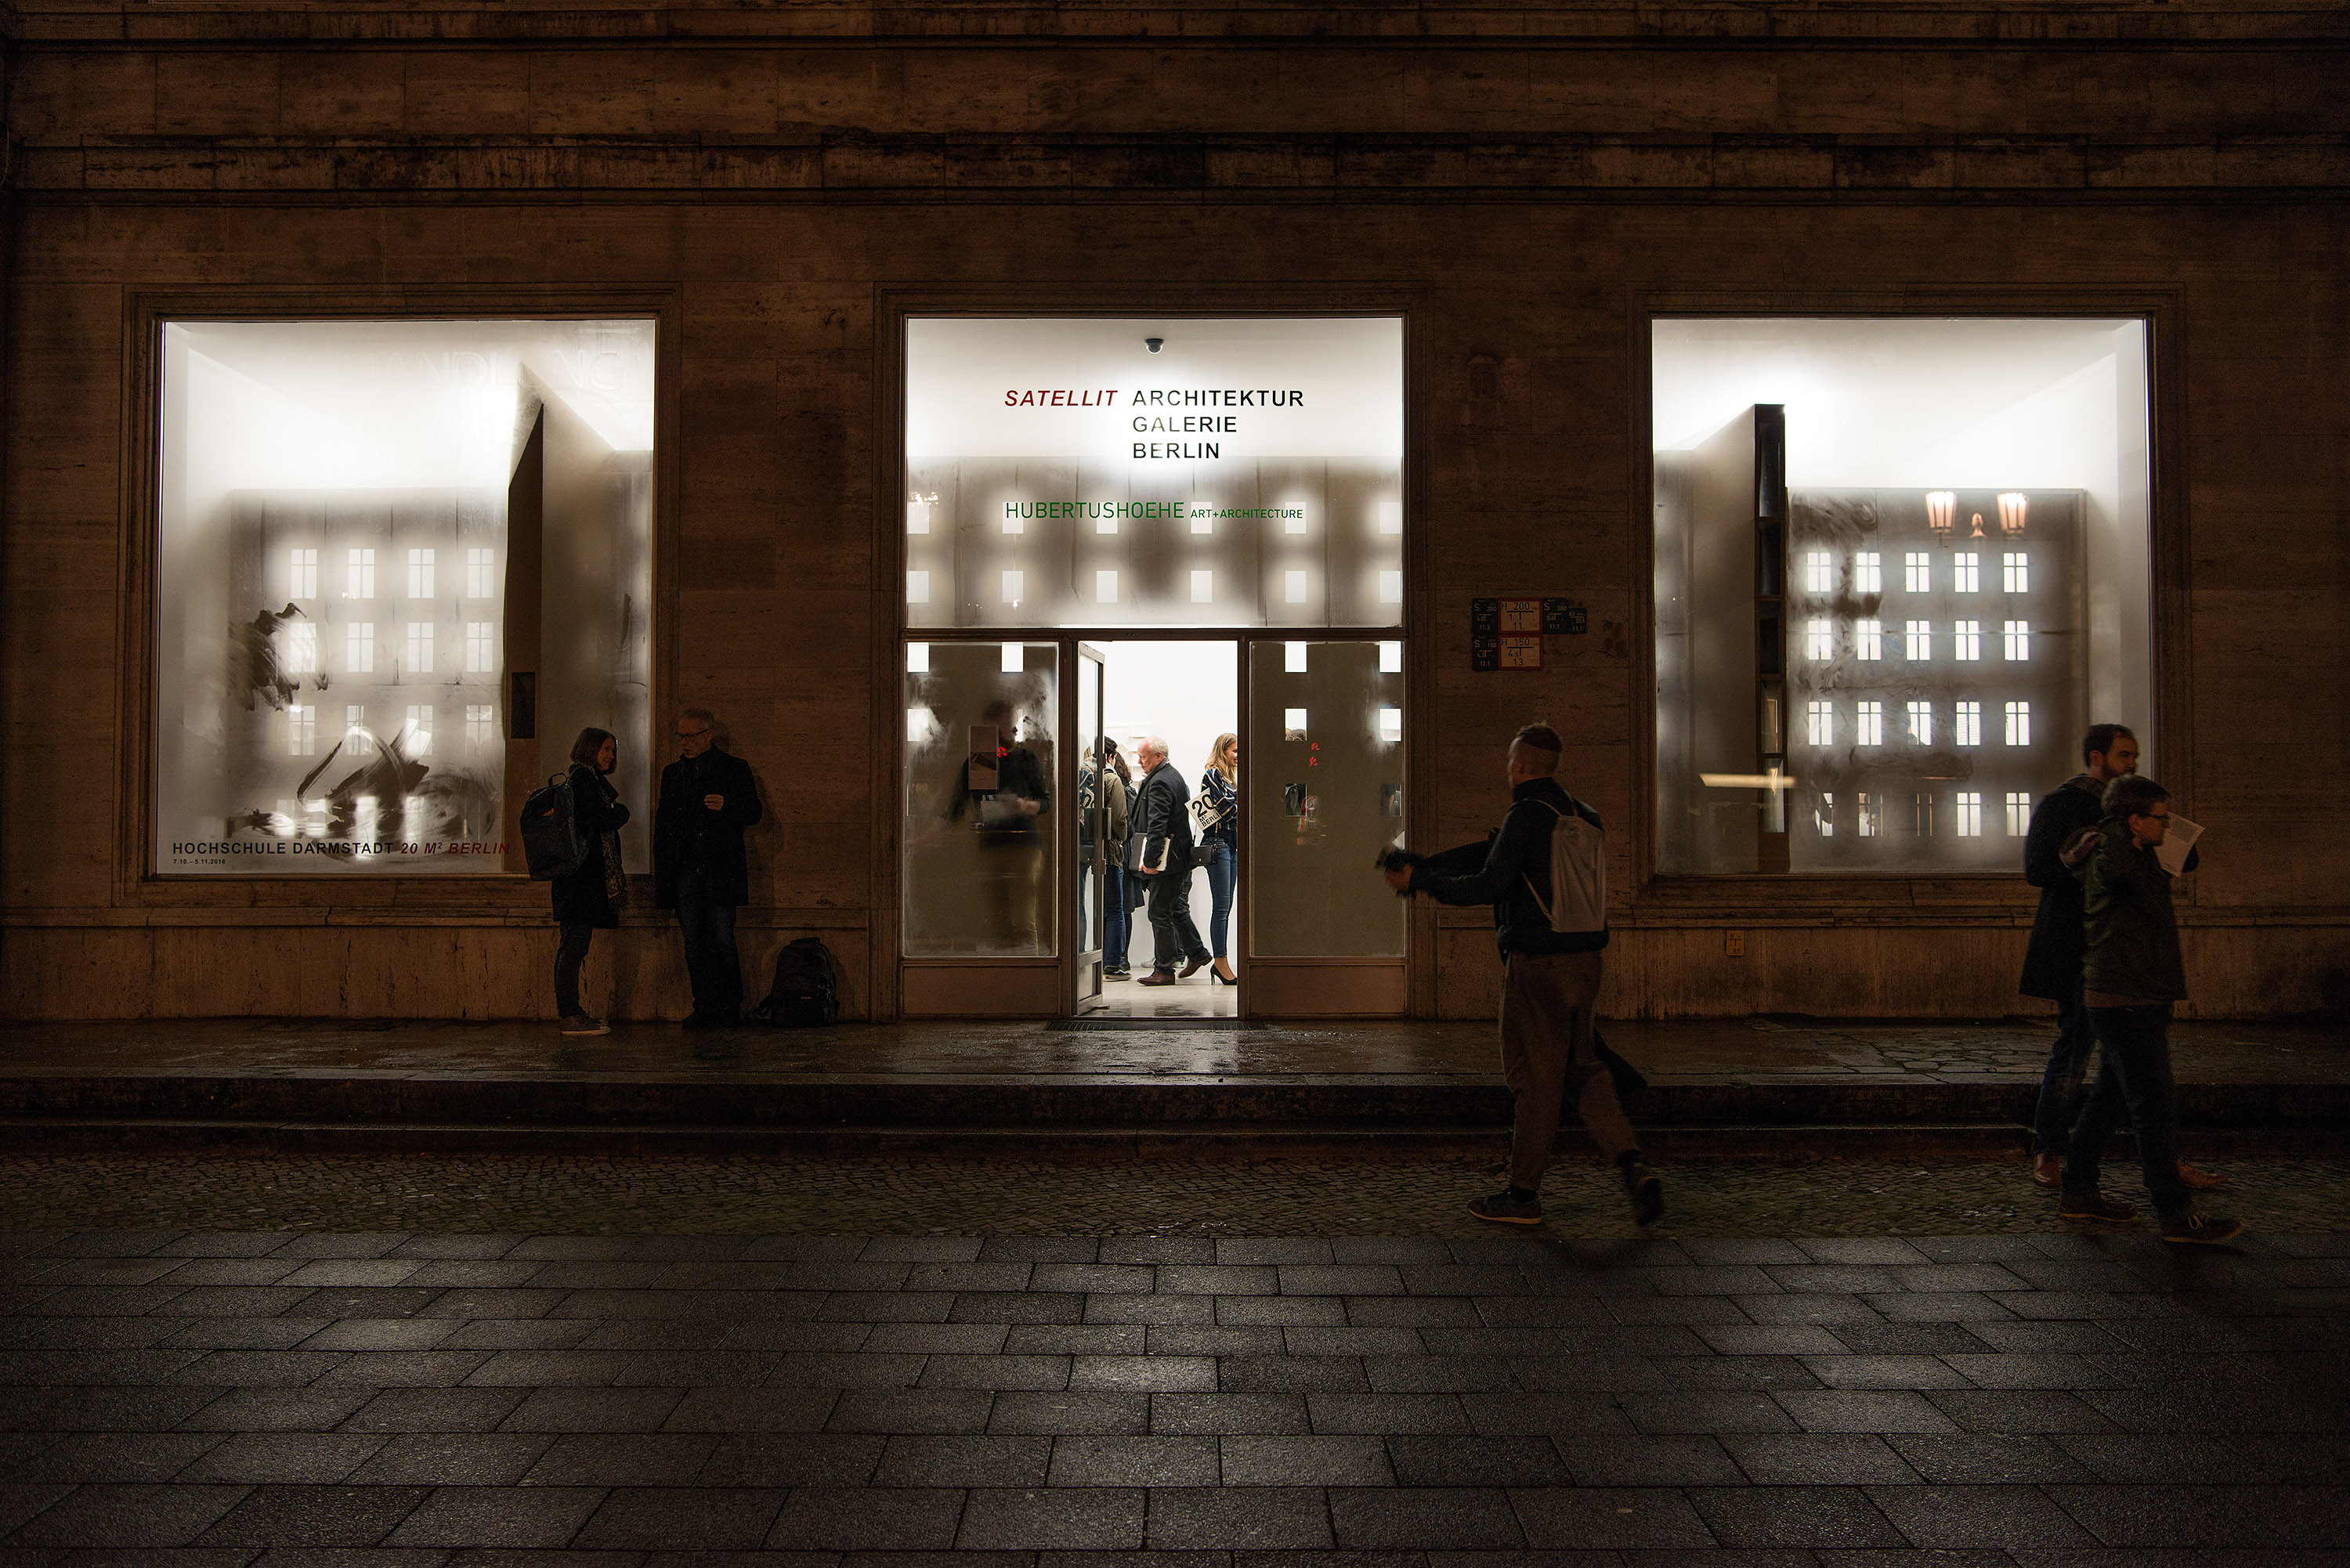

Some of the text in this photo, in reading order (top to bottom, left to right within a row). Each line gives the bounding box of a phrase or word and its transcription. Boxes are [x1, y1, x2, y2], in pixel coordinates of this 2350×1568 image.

[1003, 389, 1305, 407] SATELLIT ARCHITEKTUR
[1132, 415, 1238, 433] GALERIE
[1133, 443, 1220, 459] BERLIN
[1006, 501, 1303, 518] HUBERTUSHOEHE ART+ARCHITECTURE
[1513, 602, 1530, 610] 200
[1515, 638, 1530, 646] 150
[1191, 793, 1216, 818] 20
[1201, 812, 1220, 827] BERLI
[172, 842, 287, 854] HOCHSCHULE
[293, 842, 394, 854] DARMSTADT
[400, 842, 418, 854] 20
[448, 842, 511, 854] BERLIN
